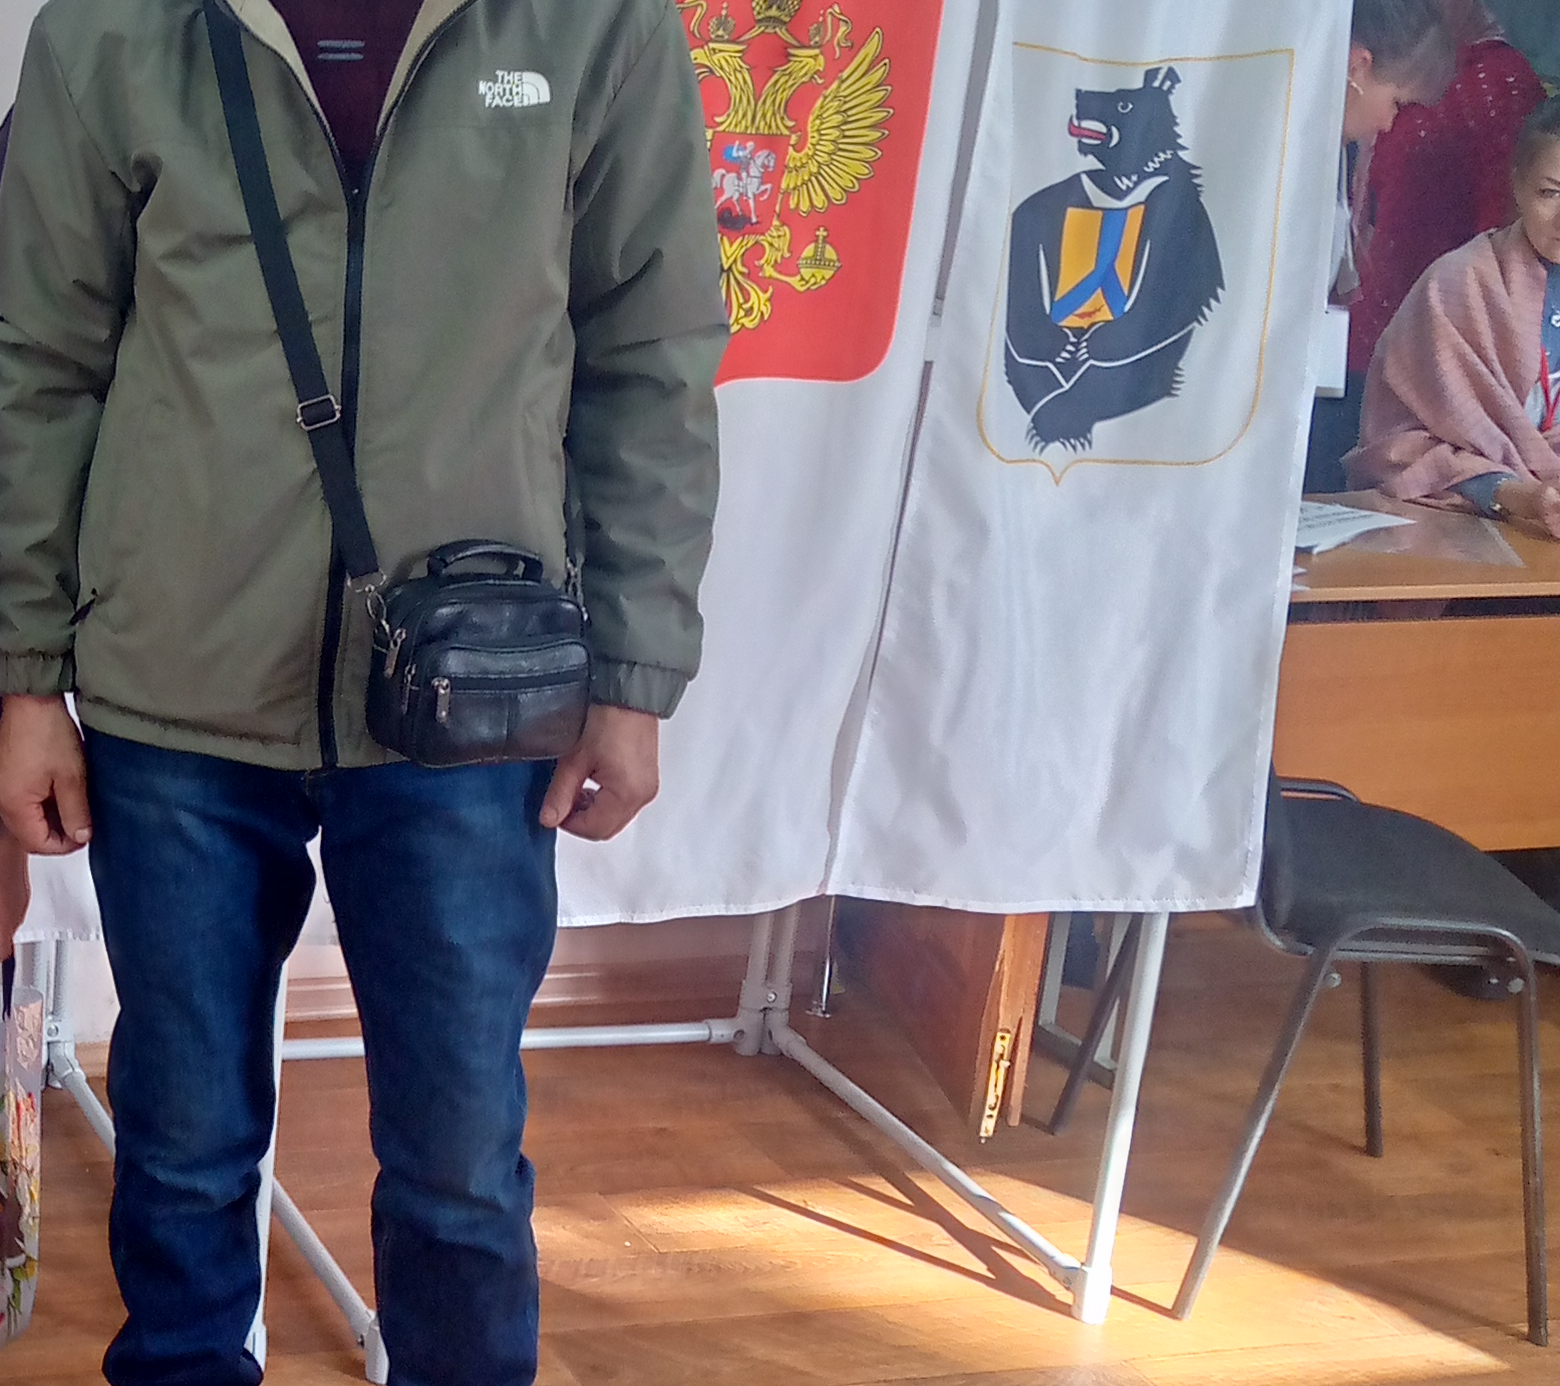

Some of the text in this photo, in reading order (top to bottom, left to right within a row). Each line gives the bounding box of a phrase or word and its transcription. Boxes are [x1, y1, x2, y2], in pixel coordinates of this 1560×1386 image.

[496, 70, 522, 84] THE
[478, 80, 522, 96] NORTH
[485, 94, 522, 108] FACE
